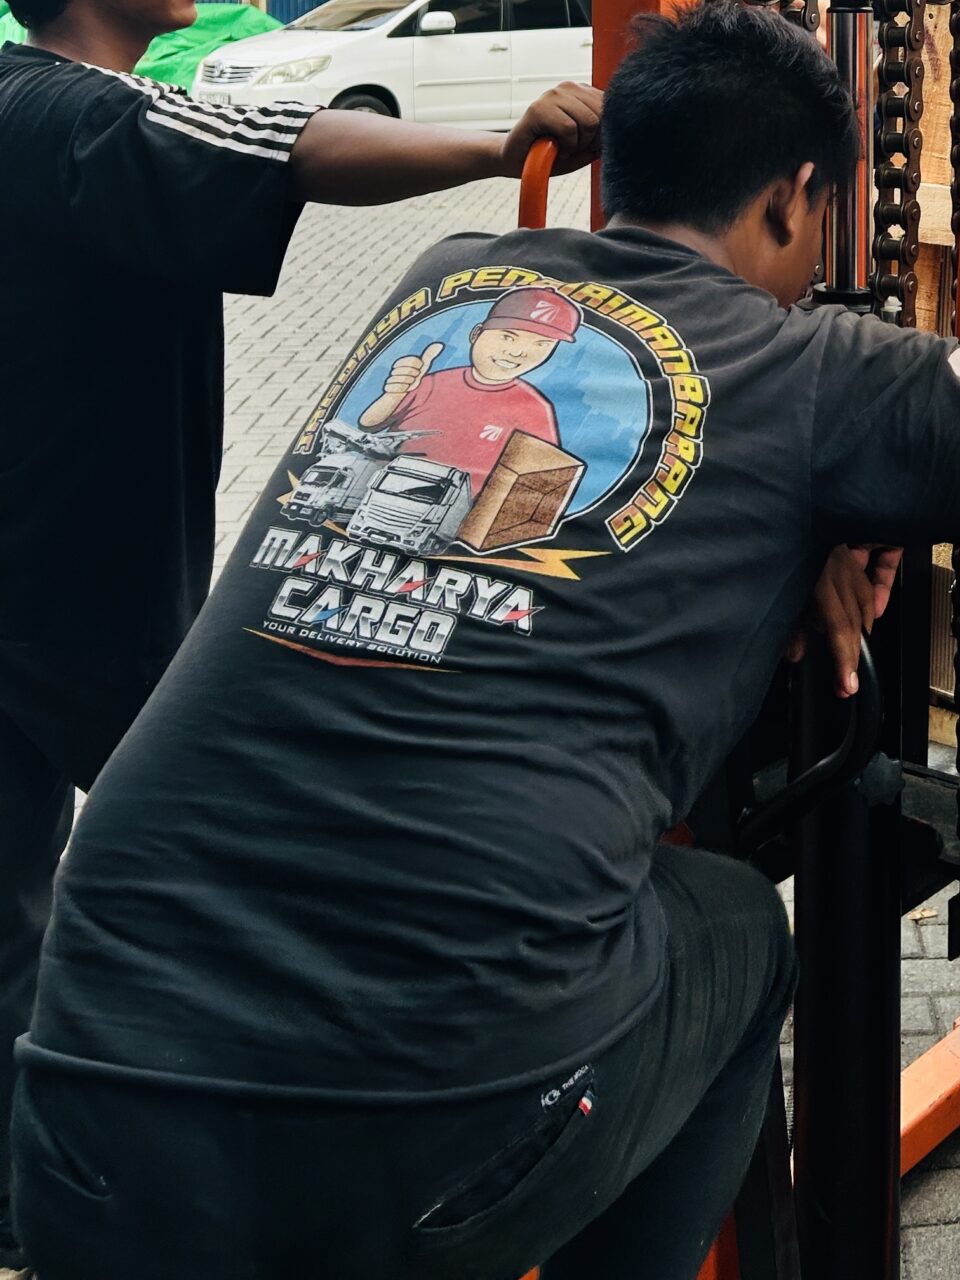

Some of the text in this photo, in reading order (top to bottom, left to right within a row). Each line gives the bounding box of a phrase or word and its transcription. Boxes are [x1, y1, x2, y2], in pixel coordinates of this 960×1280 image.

[292, 287, 432, 455] JAGONYA
[605, 375, 710, 552] BARANG
[251, 526, 541, 636] MAKHARYA
[268, 576, 457, 656] CARGO
[262, 621, 442, 664] YOUR DELIVERY SOLUTION
